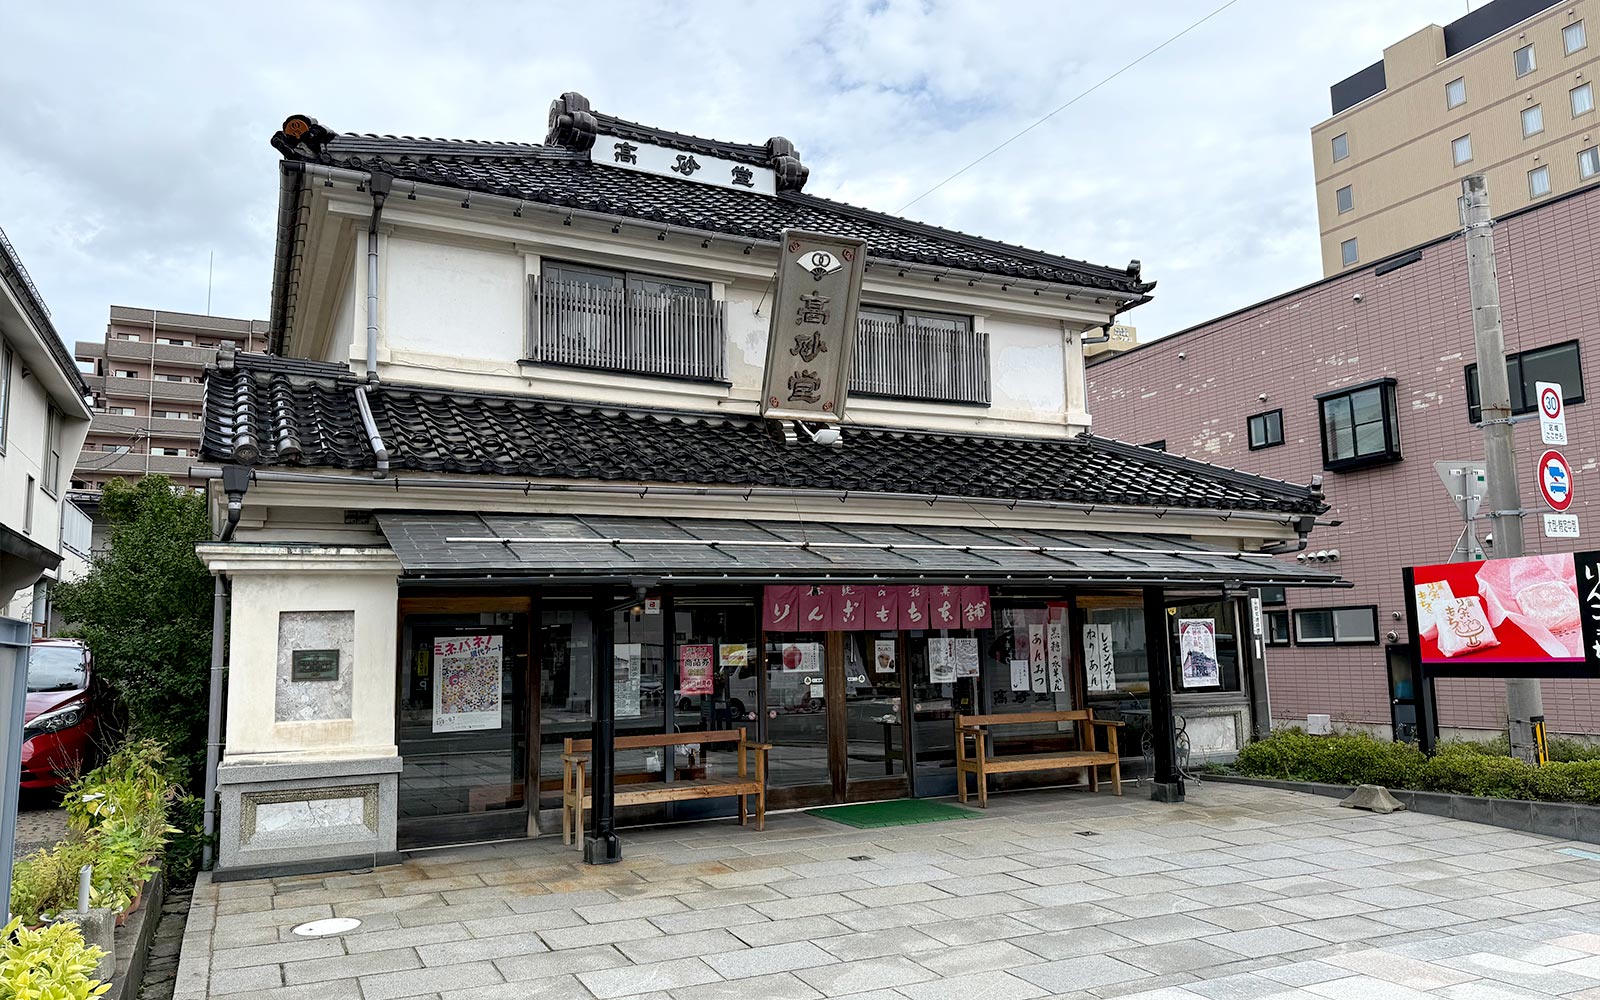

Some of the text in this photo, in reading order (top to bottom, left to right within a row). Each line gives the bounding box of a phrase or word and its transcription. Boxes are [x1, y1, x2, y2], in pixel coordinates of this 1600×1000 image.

[1545, 396, 1557, 411] 30
[684, 658, 710, 667] 商品券
[1032, 633, 1045, 685] あんみつ
[1086, 628, 1099, 686] ねりあん
